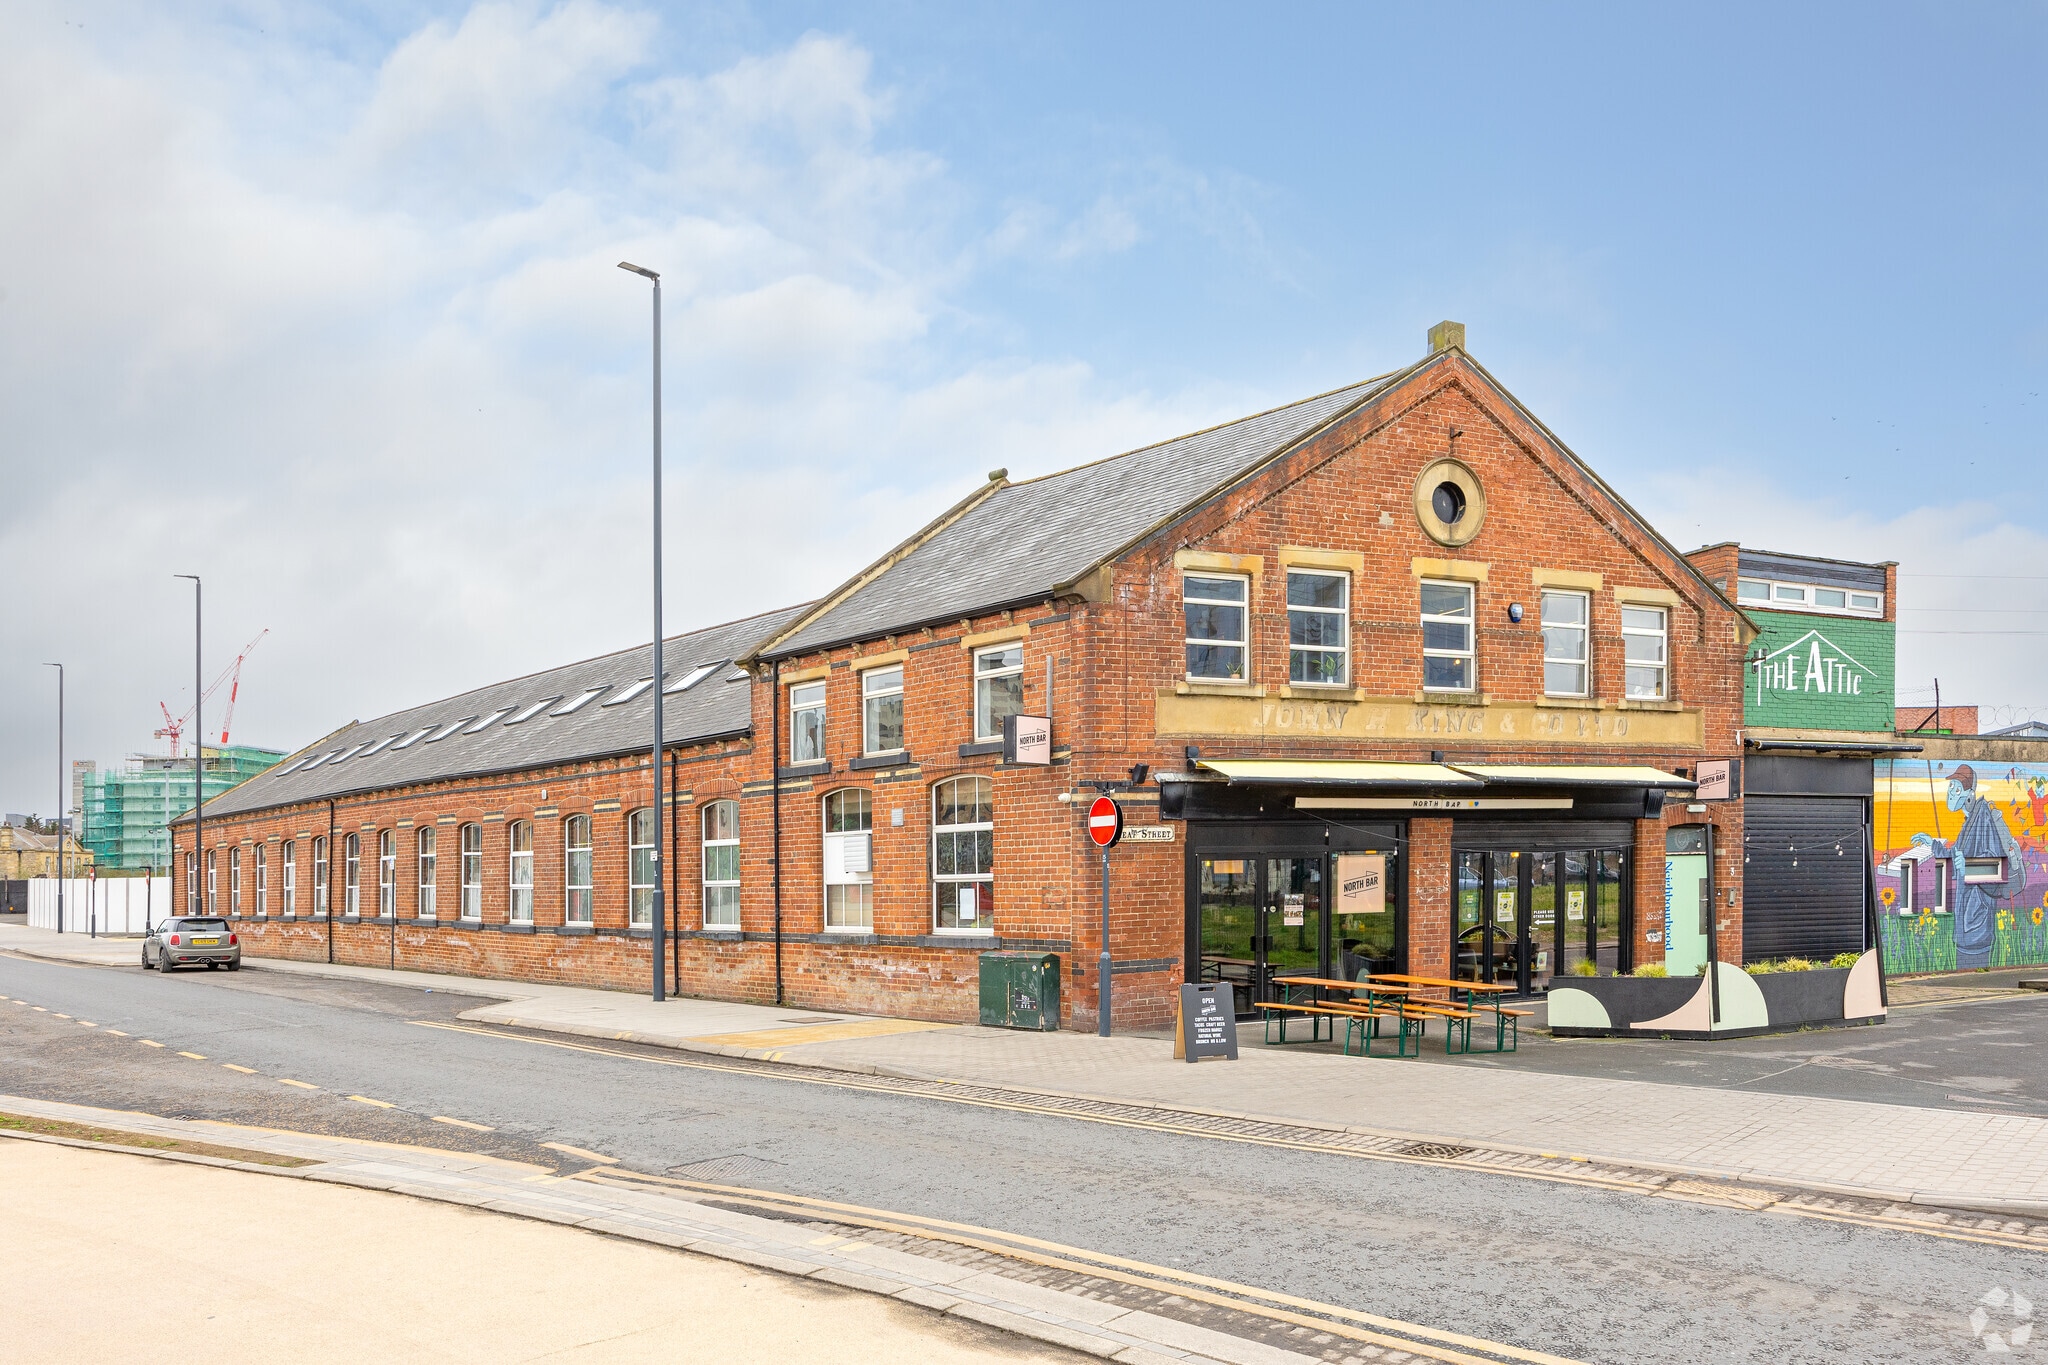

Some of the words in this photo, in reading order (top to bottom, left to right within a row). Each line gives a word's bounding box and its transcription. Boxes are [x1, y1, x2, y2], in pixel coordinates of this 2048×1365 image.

[1763, 654, 1800, 690] THE
[1253, 704, 1349, 731] JOHN
[1365, 707, 1392, 731] H
[1405, 707, 1484, 733] KING
[1500, 712, 1515, 734] &
[1531, 712, 1564, 735] CO
[1019, 735, 1036, 745] NORTH
[1036, 734, 1047, 743] BAR
[1699, 776, 1715, 786] NORTH
[1715, 773, 1726, 782] BAR
[1141, 829, 1172, 839] STREET
[1730, 866, 1736, 876] 3
[1343, 879, 1364, 893] NORTH
[1365, 876, 1379, 887] BAR
[1665, 861, 1674, 951] Neighbourhood
